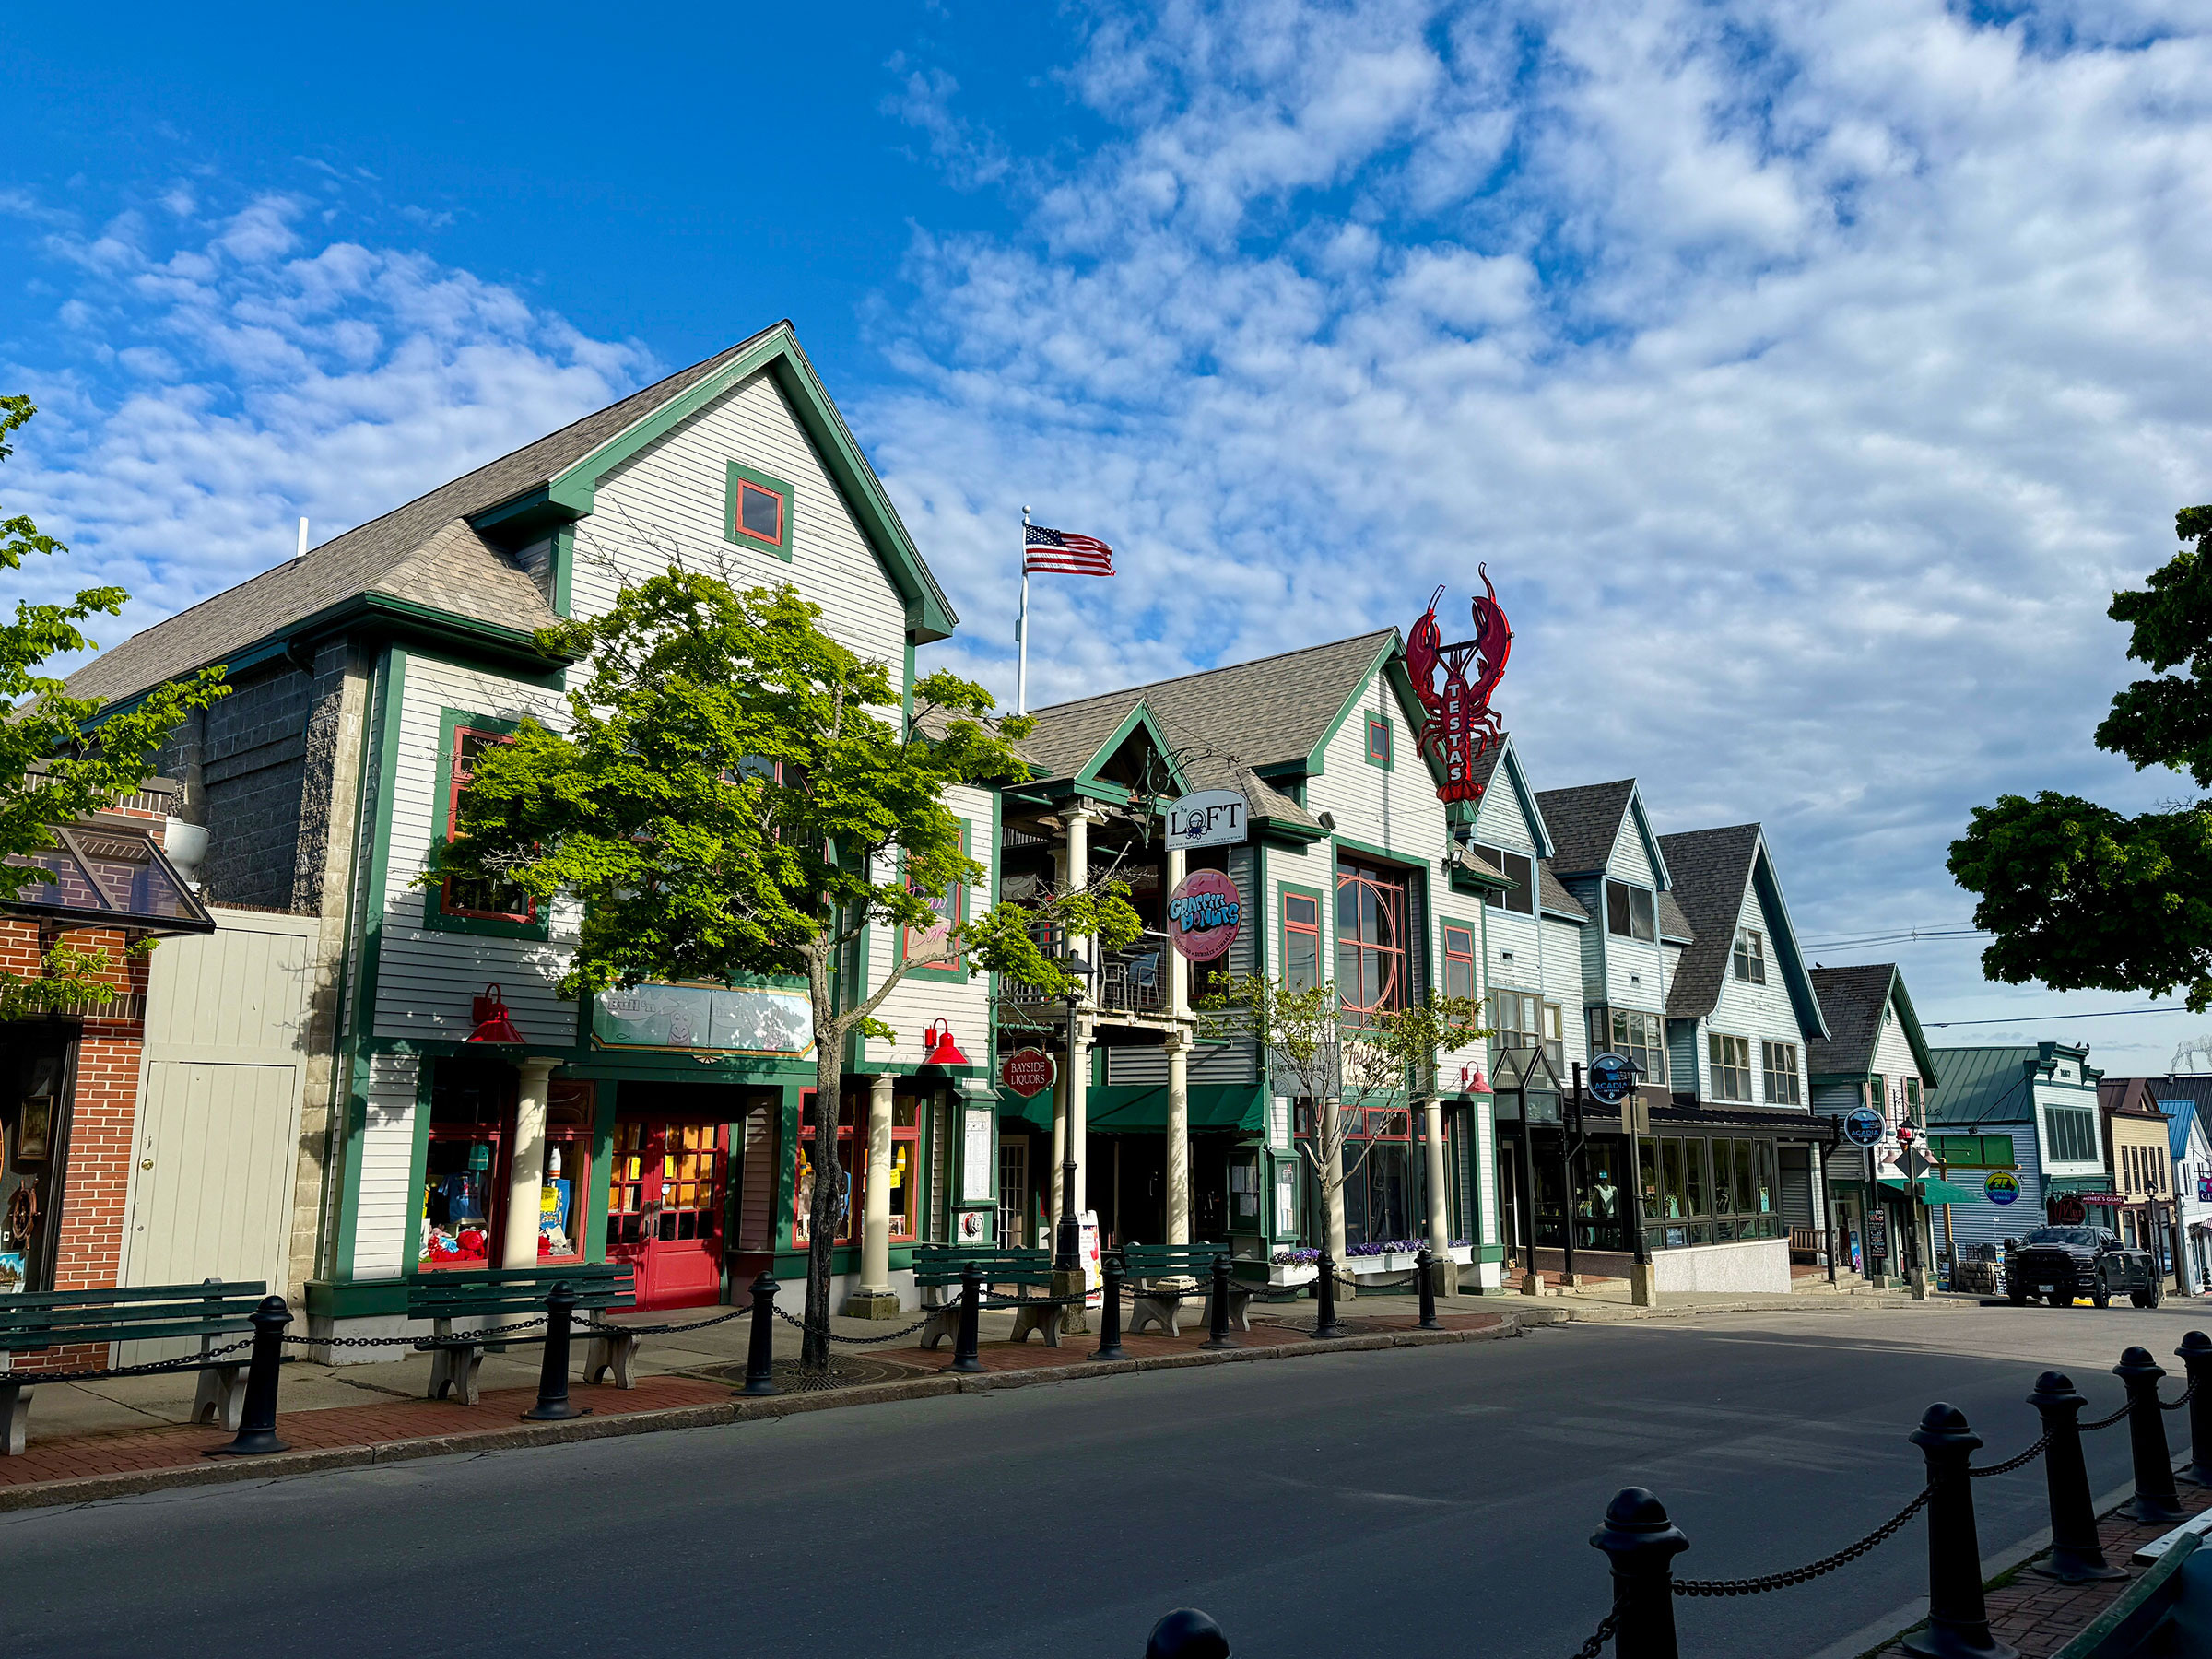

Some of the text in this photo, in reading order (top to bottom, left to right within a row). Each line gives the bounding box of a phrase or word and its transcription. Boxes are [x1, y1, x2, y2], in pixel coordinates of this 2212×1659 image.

[1171, 803, 1242, 836] LOFT
[1181, 903, 1240, 932] DONUTS
[607, 997, 640, 1012] Bull
[1011, 1062, 1045, 1073] BAYSIDE
[1011, 1074, 1045, 1086] LIQUORS
